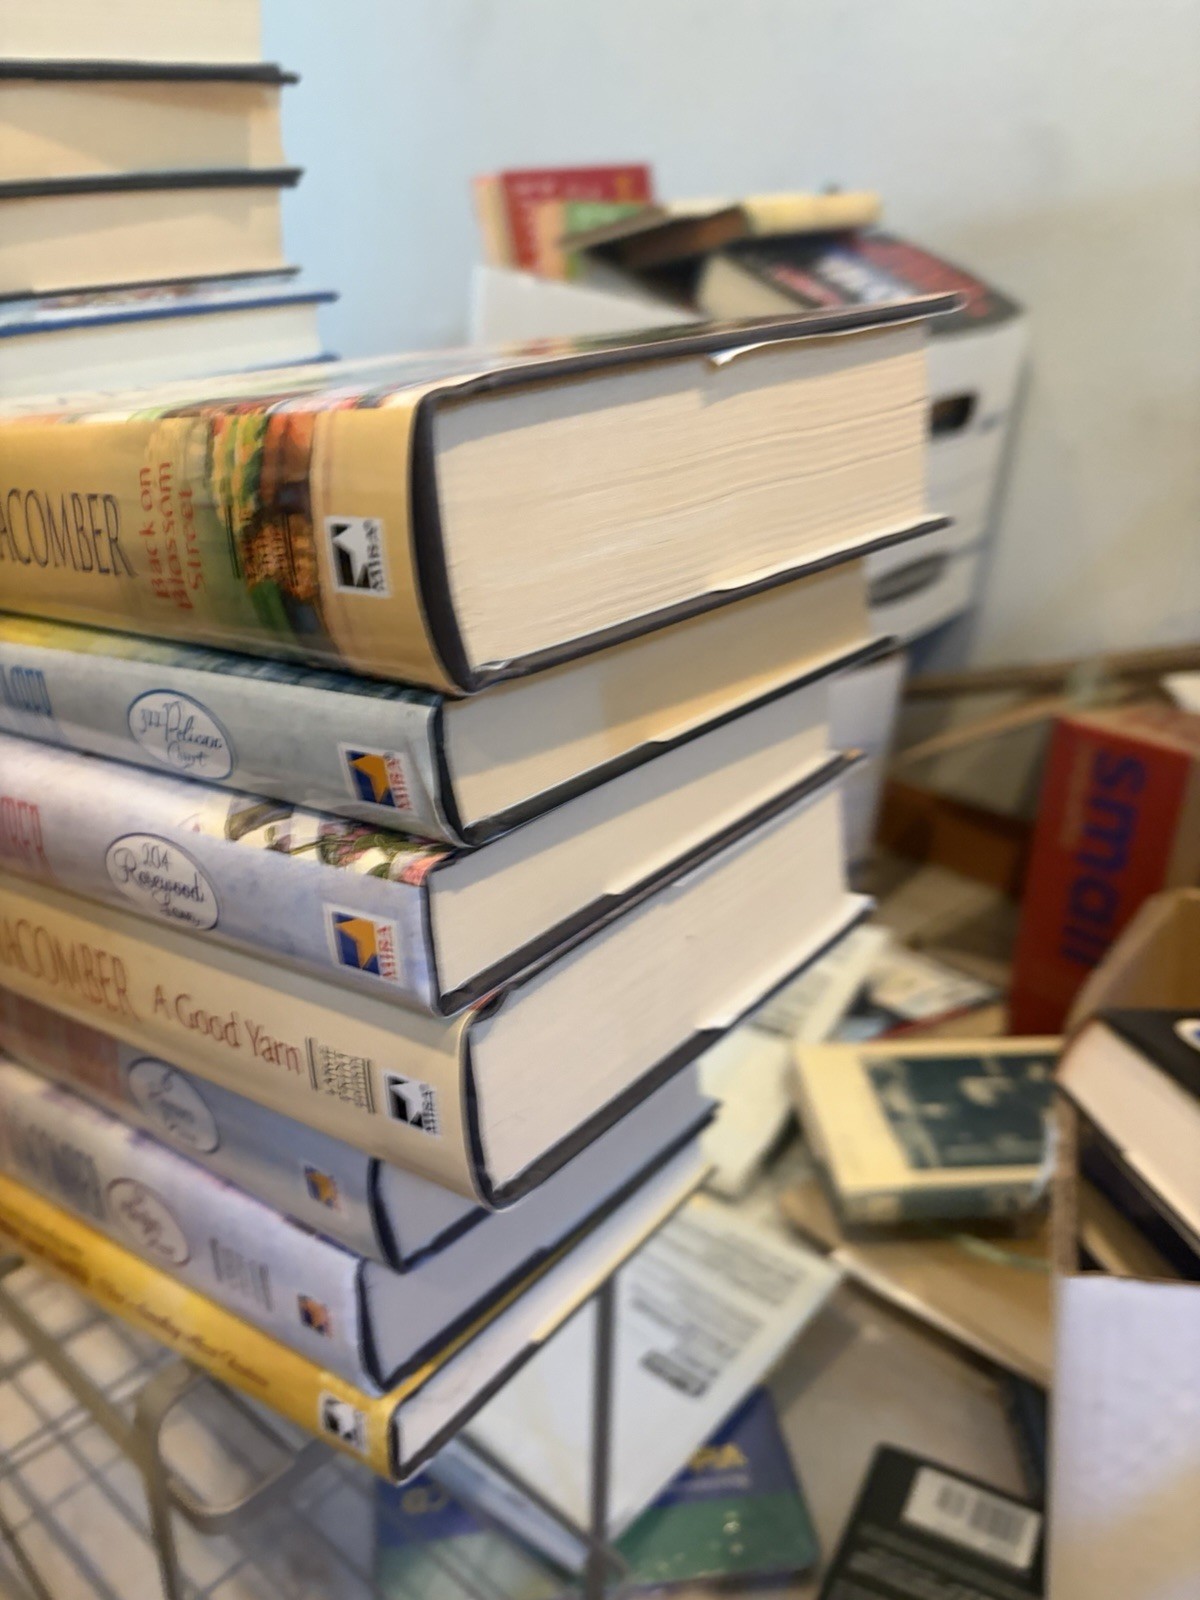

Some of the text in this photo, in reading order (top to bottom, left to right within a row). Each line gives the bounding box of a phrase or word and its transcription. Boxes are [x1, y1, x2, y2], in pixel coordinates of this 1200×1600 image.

[138, 467, 171, 598] Back on
[158, 462, 194, 610] Blossom
[178, 486, 206, 594] Street
[161, 700, 223, 749] Pelican
[387, 758, 413, 811] MIRA
[113, 846, 205, 903] Rosewood
[141, 842, 169, 871] 204
[1060, 749, 1148, 968] small
[377, 925, 398, 980] MIRA
[154, 984, 304, 1075] A Good Yarn
